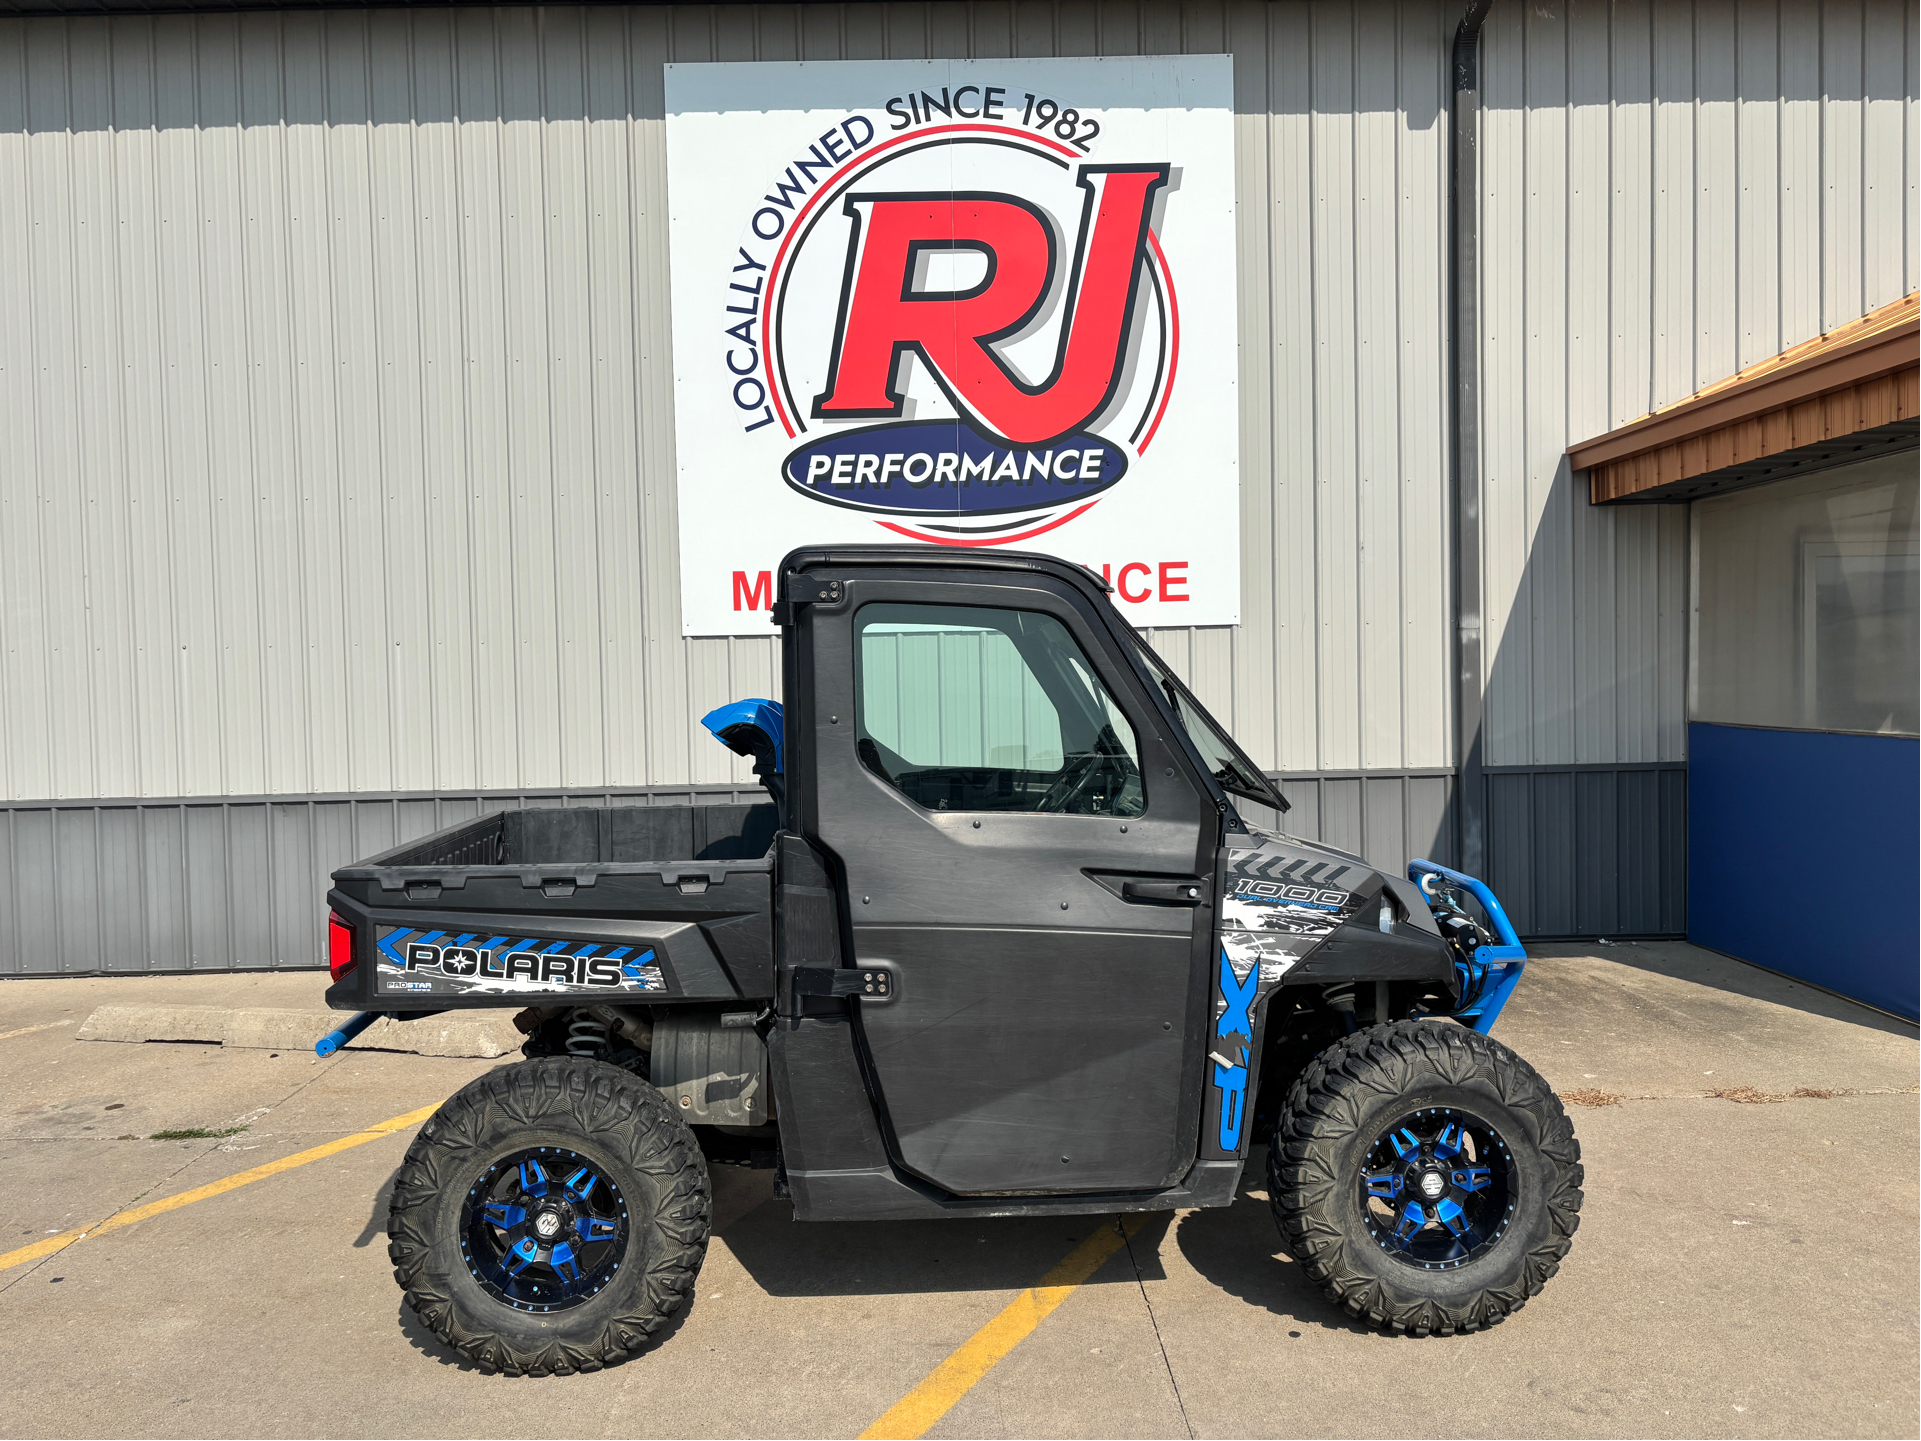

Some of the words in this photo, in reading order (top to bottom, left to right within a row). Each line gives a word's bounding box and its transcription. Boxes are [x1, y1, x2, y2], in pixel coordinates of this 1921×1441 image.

[725, 247, 774, 433] LOCALLY
[752, 116, 873, 240] OWNED
[886, 86, 1006, 131] SINCE
[1023, 93, 1100, 153] 1982
[810, 162, 1172, 449] RJ
[806, 448, 1104, 484] PERFORMANCE
[1234, 878, 1350, 907] 1000
[1236, 893, 1264, 901] DUAL
[1318, 904, 1340, 912] CAM
[405, 942, 623, 988] POLARIS
[386, 981, 433, 989] PROSTAR
